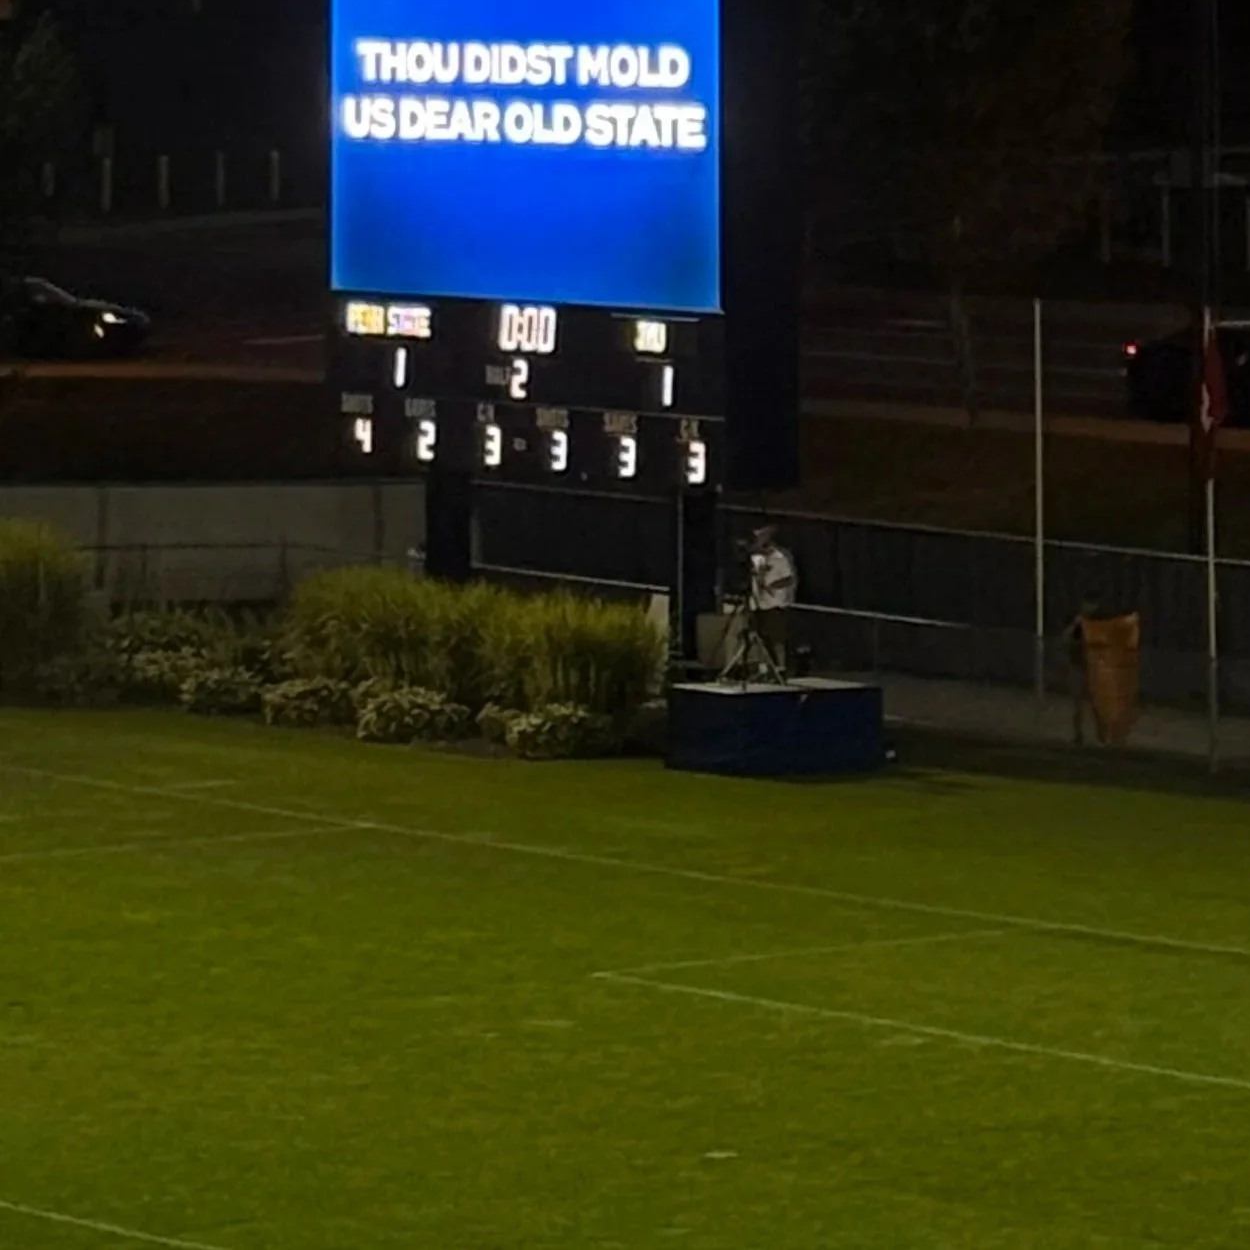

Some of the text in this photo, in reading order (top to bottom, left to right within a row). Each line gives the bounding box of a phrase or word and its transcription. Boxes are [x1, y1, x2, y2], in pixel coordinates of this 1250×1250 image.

[357, 40, 690, 88] THOU DIDST MOLD
[343, 97, 706, 148] US DEAR OLD STATE
[498, 304, 556, 353] 0:00
[394, 347, 407, 388] 1
[510, 358, 529, 399] 2
[661, 365, 674, 407] 1
[355, 417, 372, 453] 4
[417, 419, 436, 461] 2
[484, 424, 501, 466] 3
[550, 429, 568, 471] 3
[619, 435, 636, 478] 3
[687, 440, 706, 483] 3
